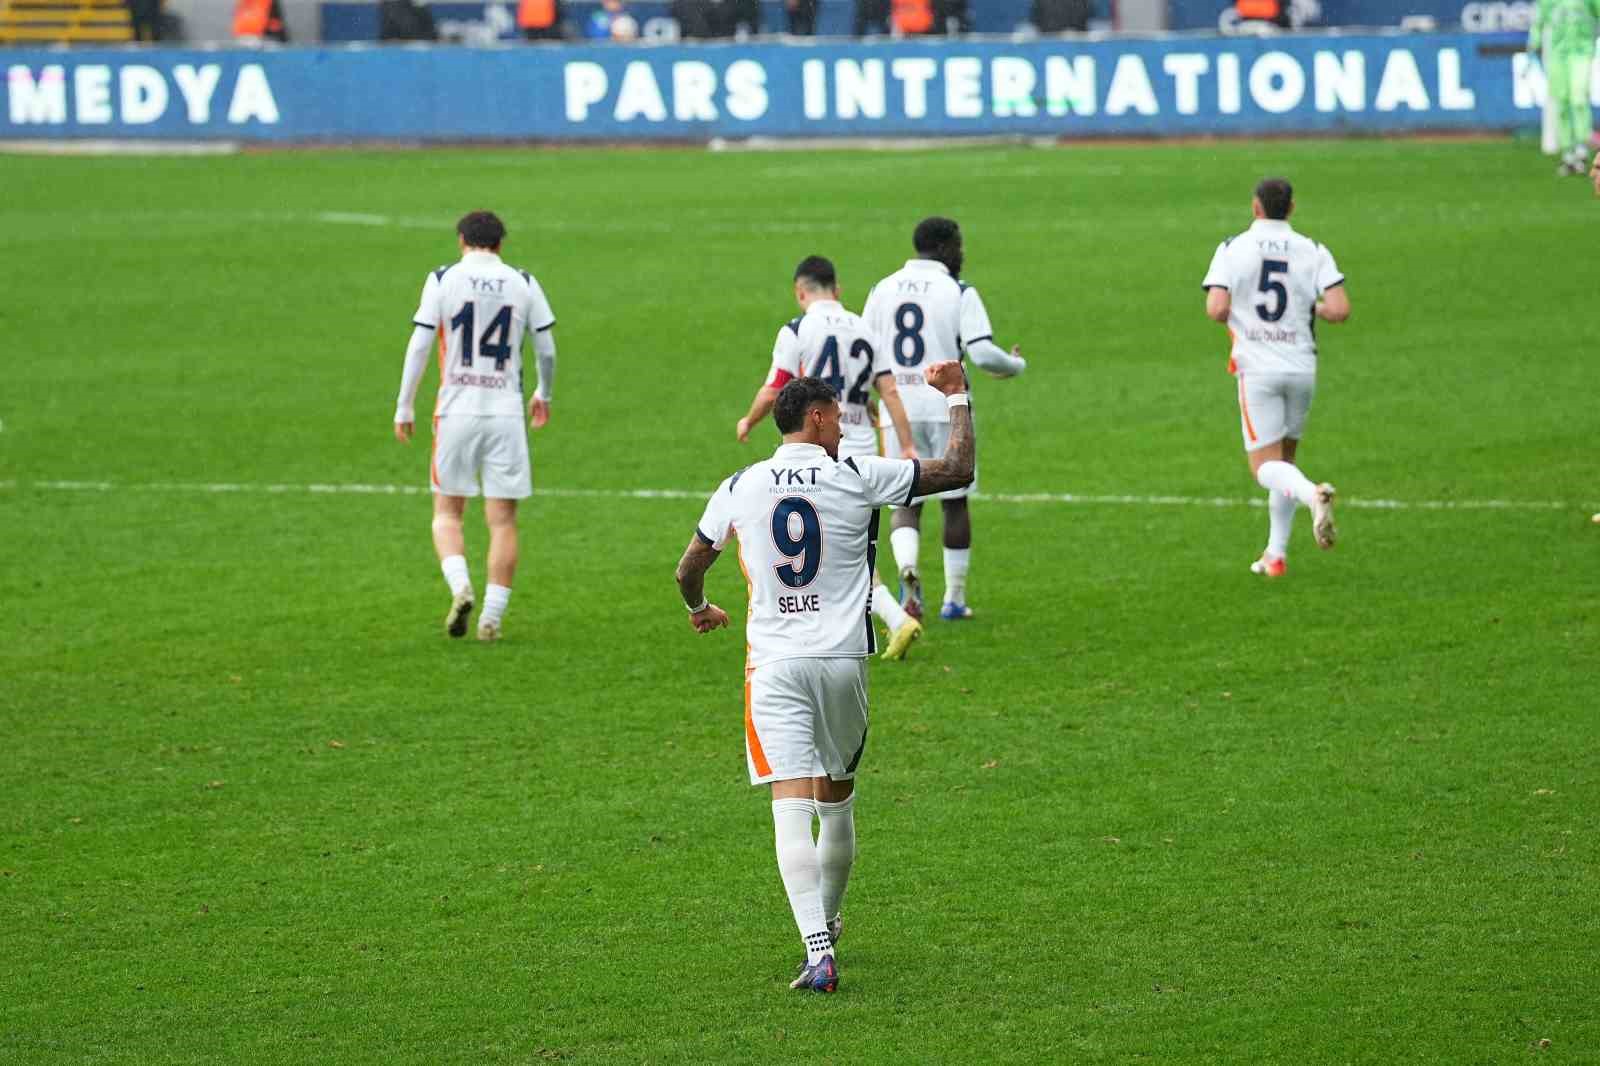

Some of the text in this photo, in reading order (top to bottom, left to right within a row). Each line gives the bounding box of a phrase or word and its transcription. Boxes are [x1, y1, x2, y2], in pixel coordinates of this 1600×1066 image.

[8, 65, 279, 125] MEDYA
[564, 60, 769, 122] PARS
[802, 49, 1475, 120] INTERNATIONAL
[469, 276, 508, 293] YKT
[1255, 259, 1289, 323] 5
[451, 301, 514, 372] 14
[893, 302, 925, 368] 8
[811, 335, 875, 406] 42
[770, 467, 822, 486] YKT
[769, 495, 824, 589] 9
[778, 594, 821, 614] SELKE
